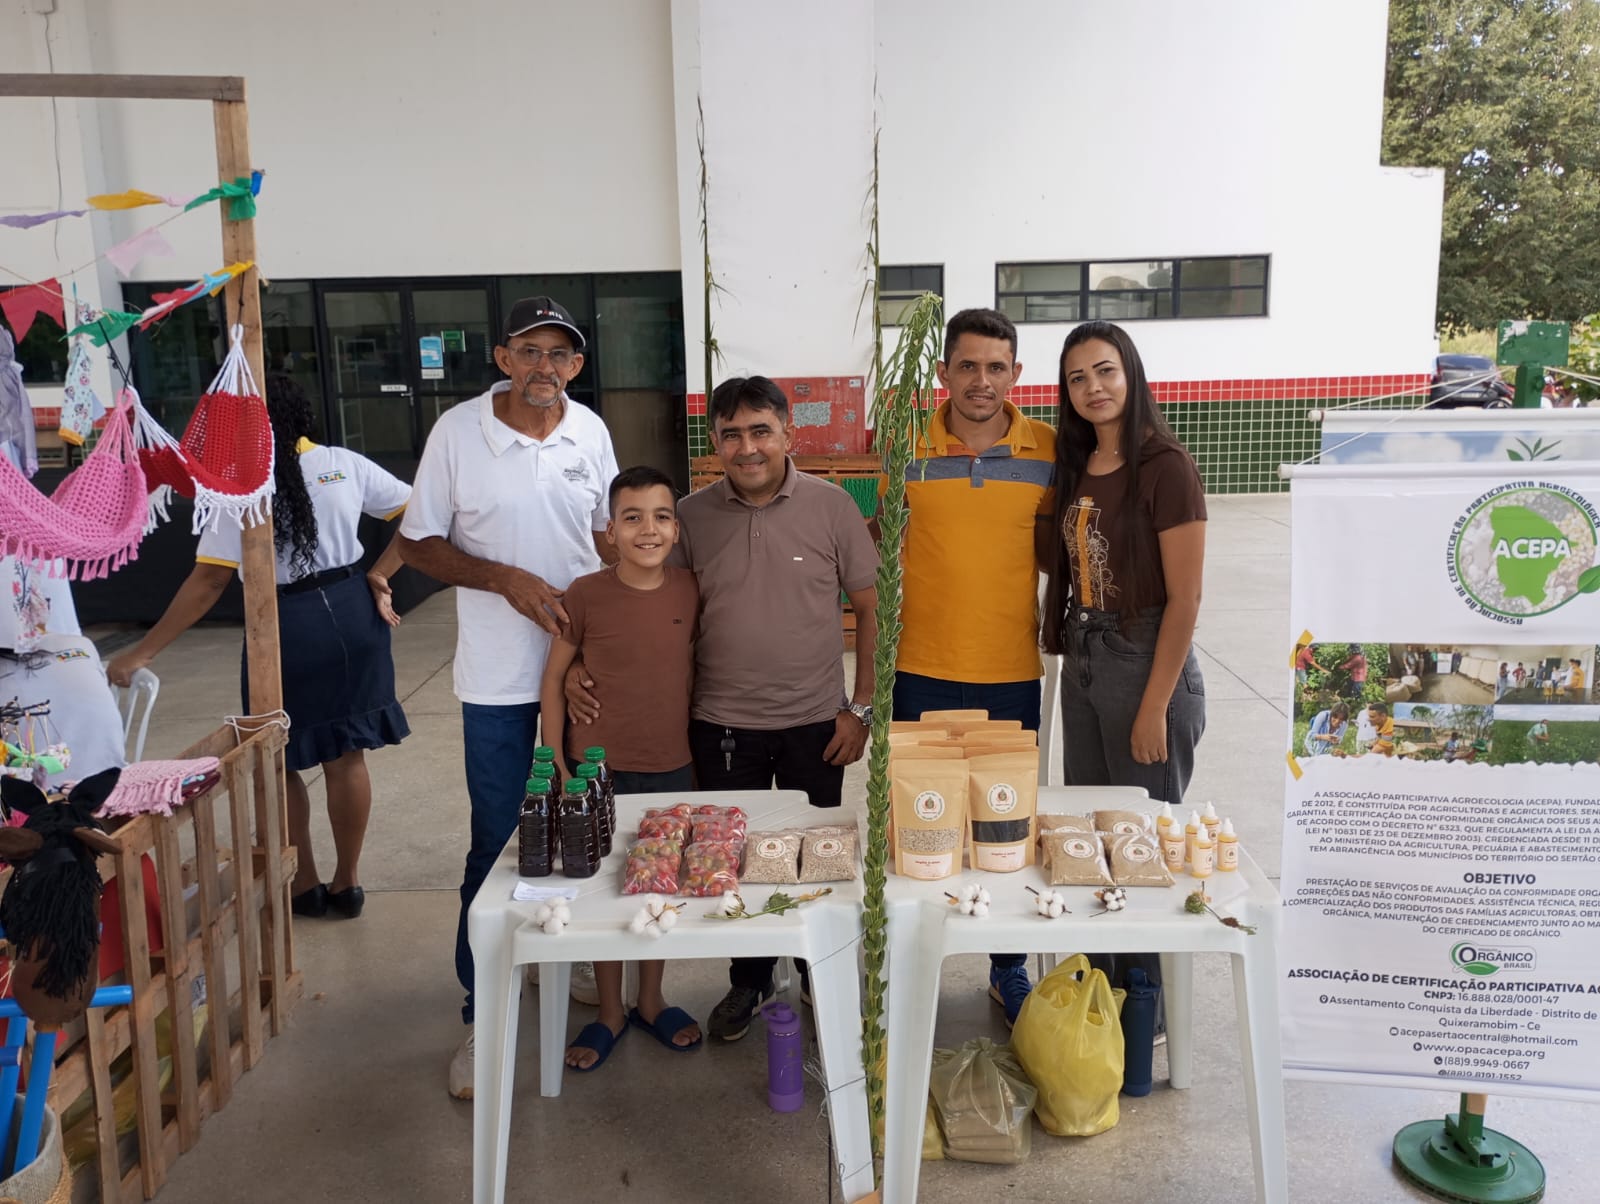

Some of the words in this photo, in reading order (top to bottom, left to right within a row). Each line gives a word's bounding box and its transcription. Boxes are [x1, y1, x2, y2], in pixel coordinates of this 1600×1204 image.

[536, 310, 564, 320] PARIS
[1454, 584, 1466, 597] DE
[1466, 480, 1535, 514] PARTICIPATIVA
[1492, 538, 1571, 559] ACEPA
[1322, 791, 1381, 800] ASSOCIAÇÃO
[1382, 793, 1450, 803] PARTICIPATIVA
[1451, 796, 1524, 805] AGROECOLOGIA
[1345, 802, 1406, 810] CONSTITUÍDA
[1430, 806, 1500, 814] AGRICULTORAS
[1286, 810, 1328, 818] GARANTIA
[1336, 810, 1402, 820] CERTIFICAÇÃO
[1419, 814, 1494, 824] CONFORMIDADE
[1496, 816, 1544, 824] ORGÂNICA
[1382, 822, 1424, 830] DECRETO
[1486, 826, 1553, 834] REGULAMENTA
[1400, 832, 1453, 840] DEZEMBRO
[1334, 837, 1387, 846] MINISTÉRIO
[1472, 844, 1518, 852] PECUÁRIA
[1329, 846, 1395, 856] ABRANGÊNCIA
[1418, 852, 1473, 860] MUNICÍPIOS
[1491, 854, 1544, 862] TERRITÓRIO
[1561, 854, 1596, 862] SERTÃO
[1464, 872, 1536, 884] OBJETIVO
[1306, 878, 1358, 888] PRESTAÇÃO
[1374, 882, 1419, 892] SERVIÇOS
[1436, 886, 1487, 896] AVALIAÇÃO
[1297, 888, 1350, 896] CORREÇÕES
[1352, 890, 1370, 898] DAS
[1372, 891, 1392, 900] NÃO
[1478, 898, 1535, 906] ASSISTÊNCIA
[1288, 898, 1371, 908] COMERCIALIZAÇÃO
[1373, 902, 1392, 910] DOS
[1394, 904, 1444, 913] PRODUTOS
[1466, 908, 1507, 916] FAMÍLIAS
[1374, 912, 1439, 924] MANUTENÇÃO
[1456, 918, 1538, 926] CREDENCIAMENTO
[1572, 920, 1585, 928] AO
[1438, 927, 1498, 936] CERTIFICADO
[1458, 947, 1533, 963] ORGÂNICO
[1288, 968, 1369, 983] ASSOCIAÇÃO
[1372, 974, 1389, 984] DE
[1392, 976, 1486, 992] CERTIFICAÇÃO
[1489, 980, 1584, 994] PARTICIPATIVA
[1424, 990, 1456, 1000] CNPJ:
[1458, 992, 1560, 1004] 16.888.028/0001-47
[1330, 996, 1406, 1010] Assentamento
[1408, 1002, 1462, 1014] Conquista
[1464, 1004, 1478, 1015] da
[1480, 1007, 1532, 1017] Liberdade
[1542, 1009, 1581, 1019] Distrito
[1584, 1010, 1598, 1020] de
[1439, 1018, 1518, 1030] Quixeramobim
[1527, 1022, 1541, 1031] Ce
[1400, 1029, 1578, 1046] acepasertaocentral@hotmail.com
[1423, 1044, 1546, 1059] www.opacacepa.org
